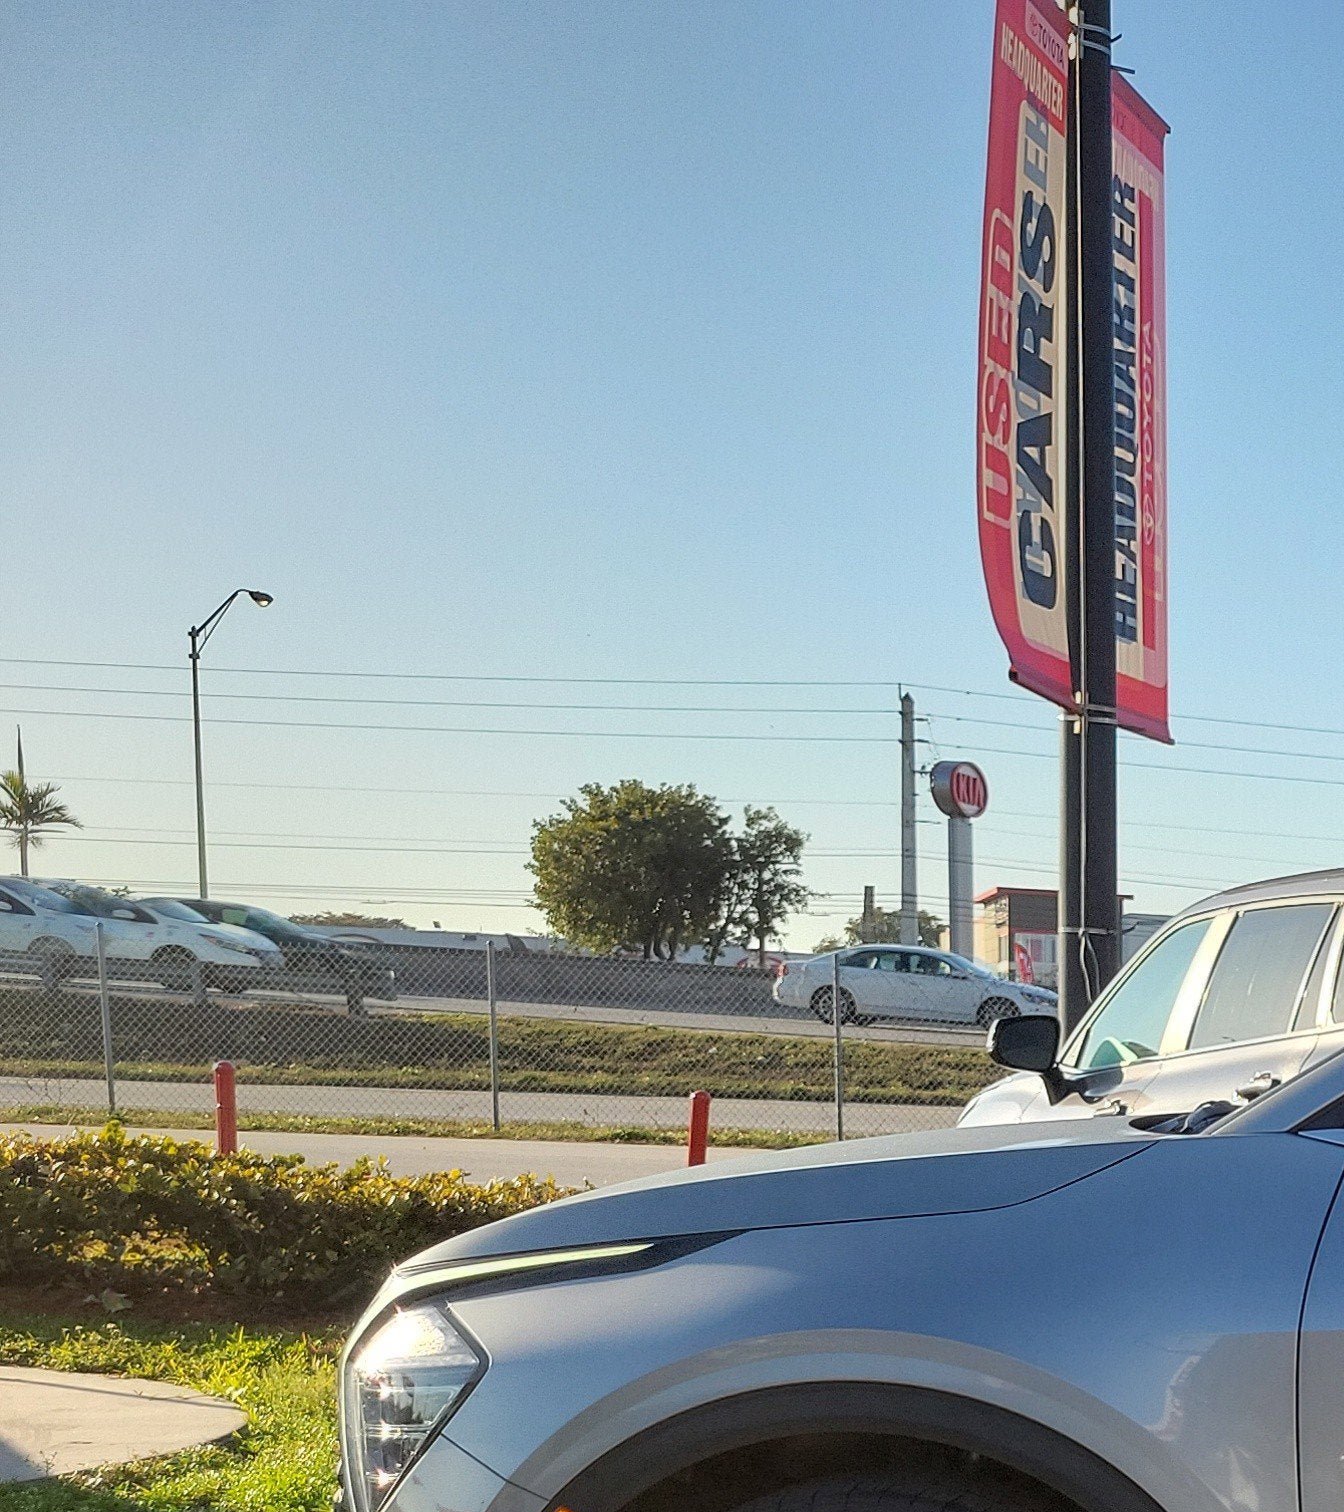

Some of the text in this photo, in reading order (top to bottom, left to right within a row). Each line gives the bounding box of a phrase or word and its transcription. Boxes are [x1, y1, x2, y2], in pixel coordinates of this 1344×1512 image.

[1001, 22, 1064, 122] HEADQUARTER
[1037, 23, 1065, 70] TOYOTA
[981, 208, 1014, 530] USED
[1016, 189, 1057, 611] CARS
[1142, 319, 1153, 485] TOYOTA
